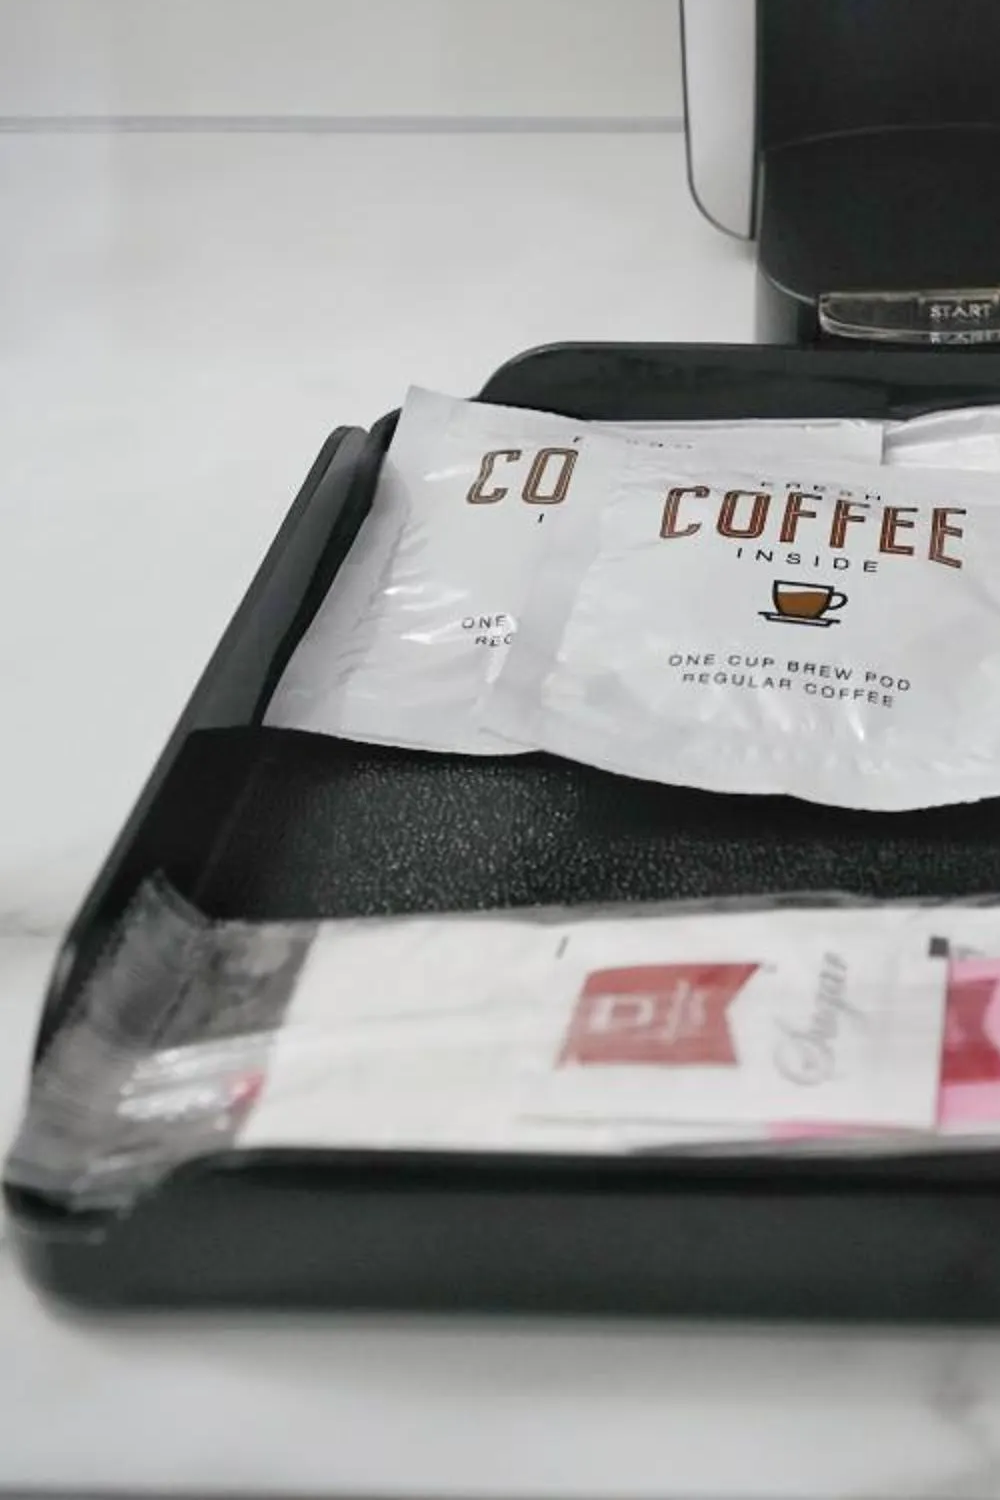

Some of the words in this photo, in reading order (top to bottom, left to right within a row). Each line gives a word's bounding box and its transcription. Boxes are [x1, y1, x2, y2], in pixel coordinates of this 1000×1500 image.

[930, 303, 992, 319] START
[659, 485, 967, 569] COFFEE
[736, 546, 879, 573] INSIDE
[668, 653, 716, 667] ONE
[727, 654, 776, 669] CUP
[786, 660, 853, 682] BREW
[682, 671, 792, 691] REGULAR
[802, 682, 895, 708] COFFEE
